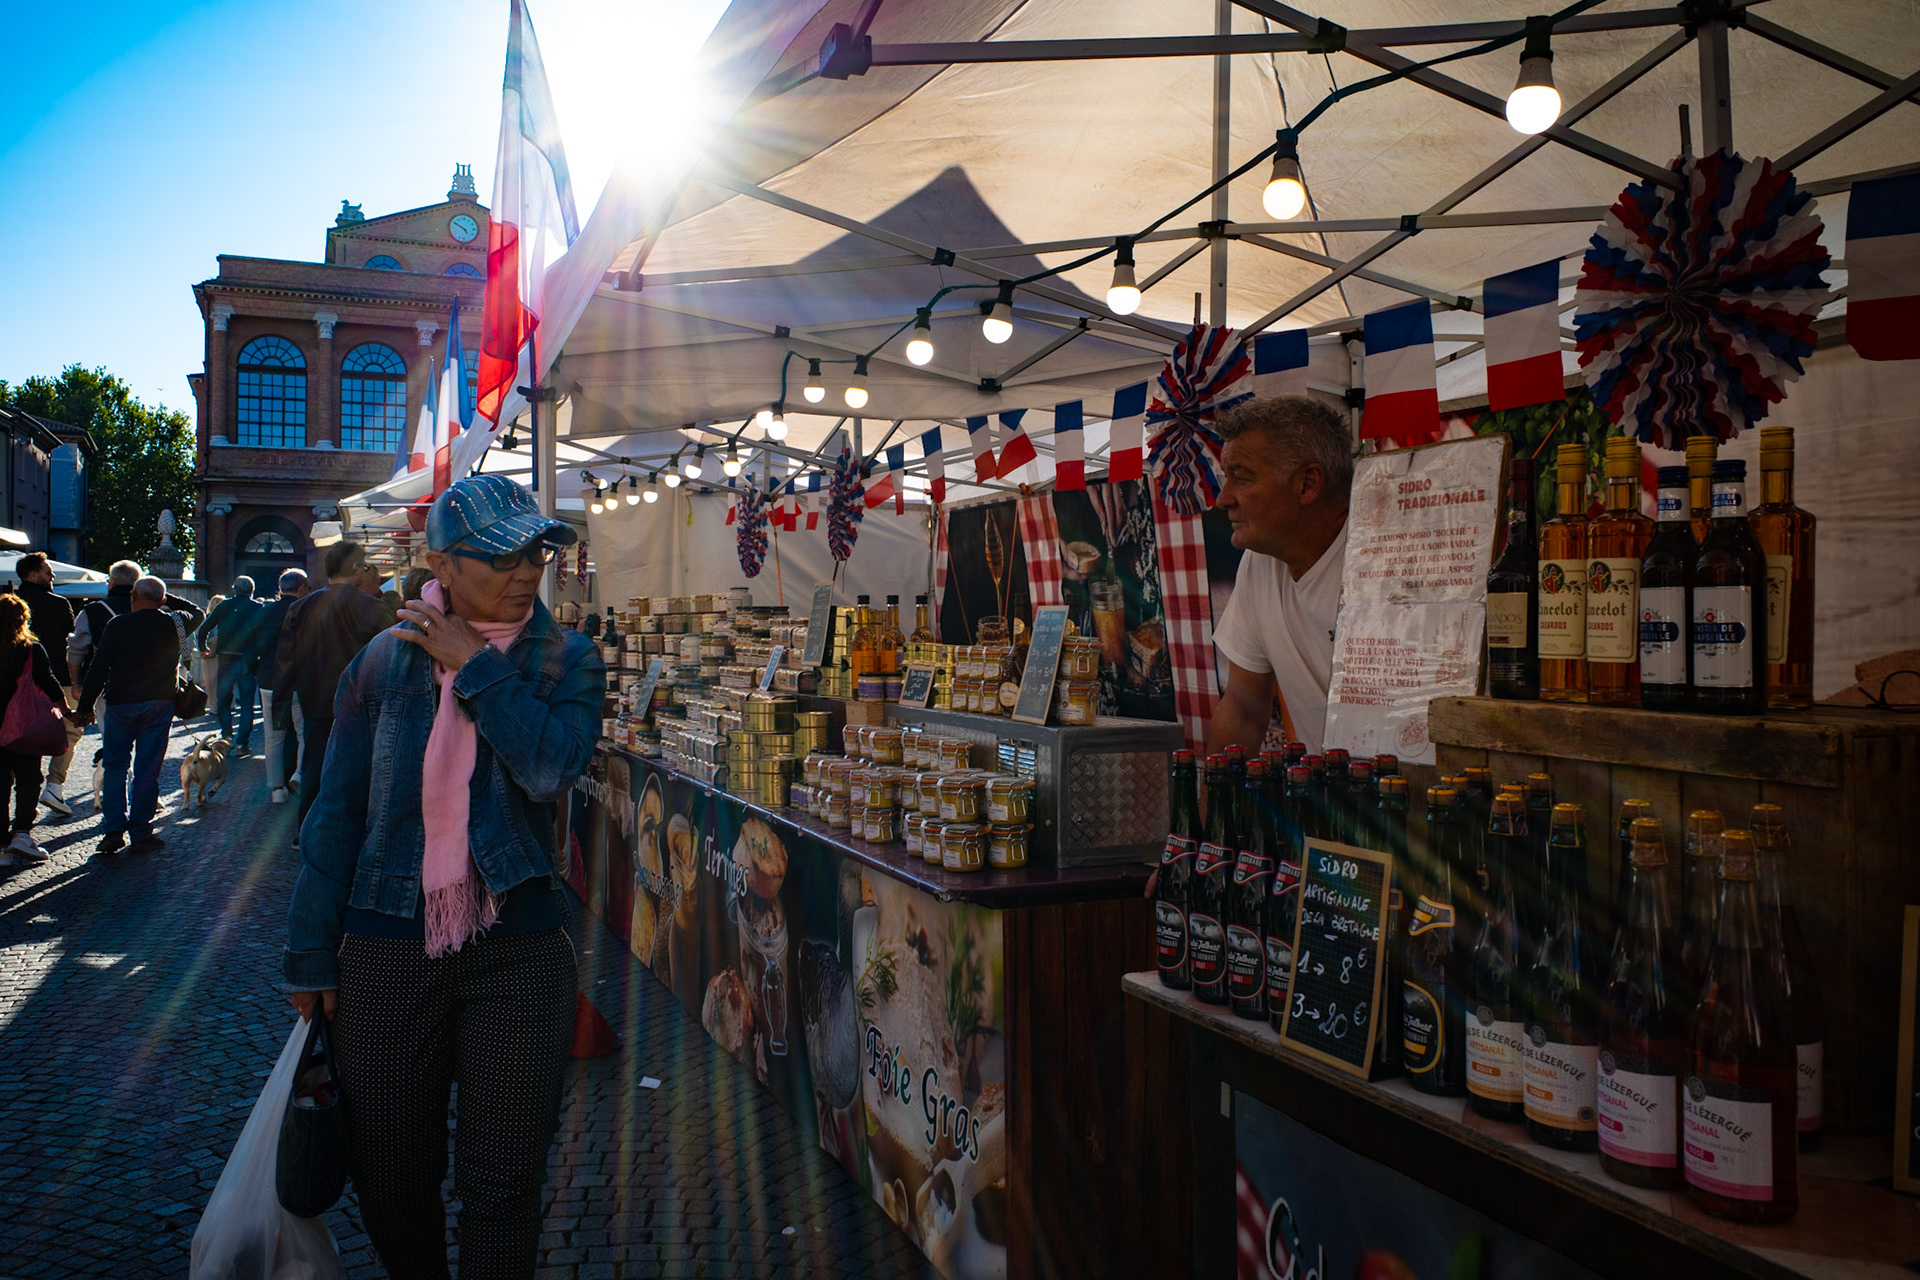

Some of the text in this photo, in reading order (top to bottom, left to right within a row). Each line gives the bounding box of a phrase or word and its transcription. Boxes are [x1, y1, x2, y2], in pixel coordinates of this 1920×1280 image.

[1398, 479, 1432, 494] SIDRO
[1397, 490, 1485, 511] TRADIZIONALE
[1370, 535, 1377, 543] IL
[1378, 533, 1407, 542] FAMOSO
[1409, 532, 1431, 541] SIDRO
[1361, 546, 1401, 555] ORIGINARIO
[1403, 544, 1425, 553] DELLA
[1428, 553, 1461, 563] SECONDO
[1448, 565, 1474, 573] ASPRE
[1427, 578, 1473, 587] NORMANDIA
[1721, 624, 1733, 632] DE
[1386, 648, 1417, 656] SAPORE
[1343, 667, 1380, 676] FRUTTATE
[1351, 678, 1376, 686] BOCCA
[1379, 678, 1394, 686] UNA
[1396, 679, 1421, 687] BELLA
[1341, 687, 1386, 696] SENSAZIONE
[705, 827, 749, 897] Terrines
[1297, 950, 1310, 973] 1
[1292, 993, 1305, 1018] 3
[1482, 1030, 1523, 1052] LÉZERGU
[1535, 1051, 1586, 1081] LÉZERGUÉ
[865, 1024, 980, 1164] Foie Gras
[1606, 1079, 1658, 1112] LÉZERGUÉ
[1694, 1105, 1752, 1142] LÉZERGUÉ
